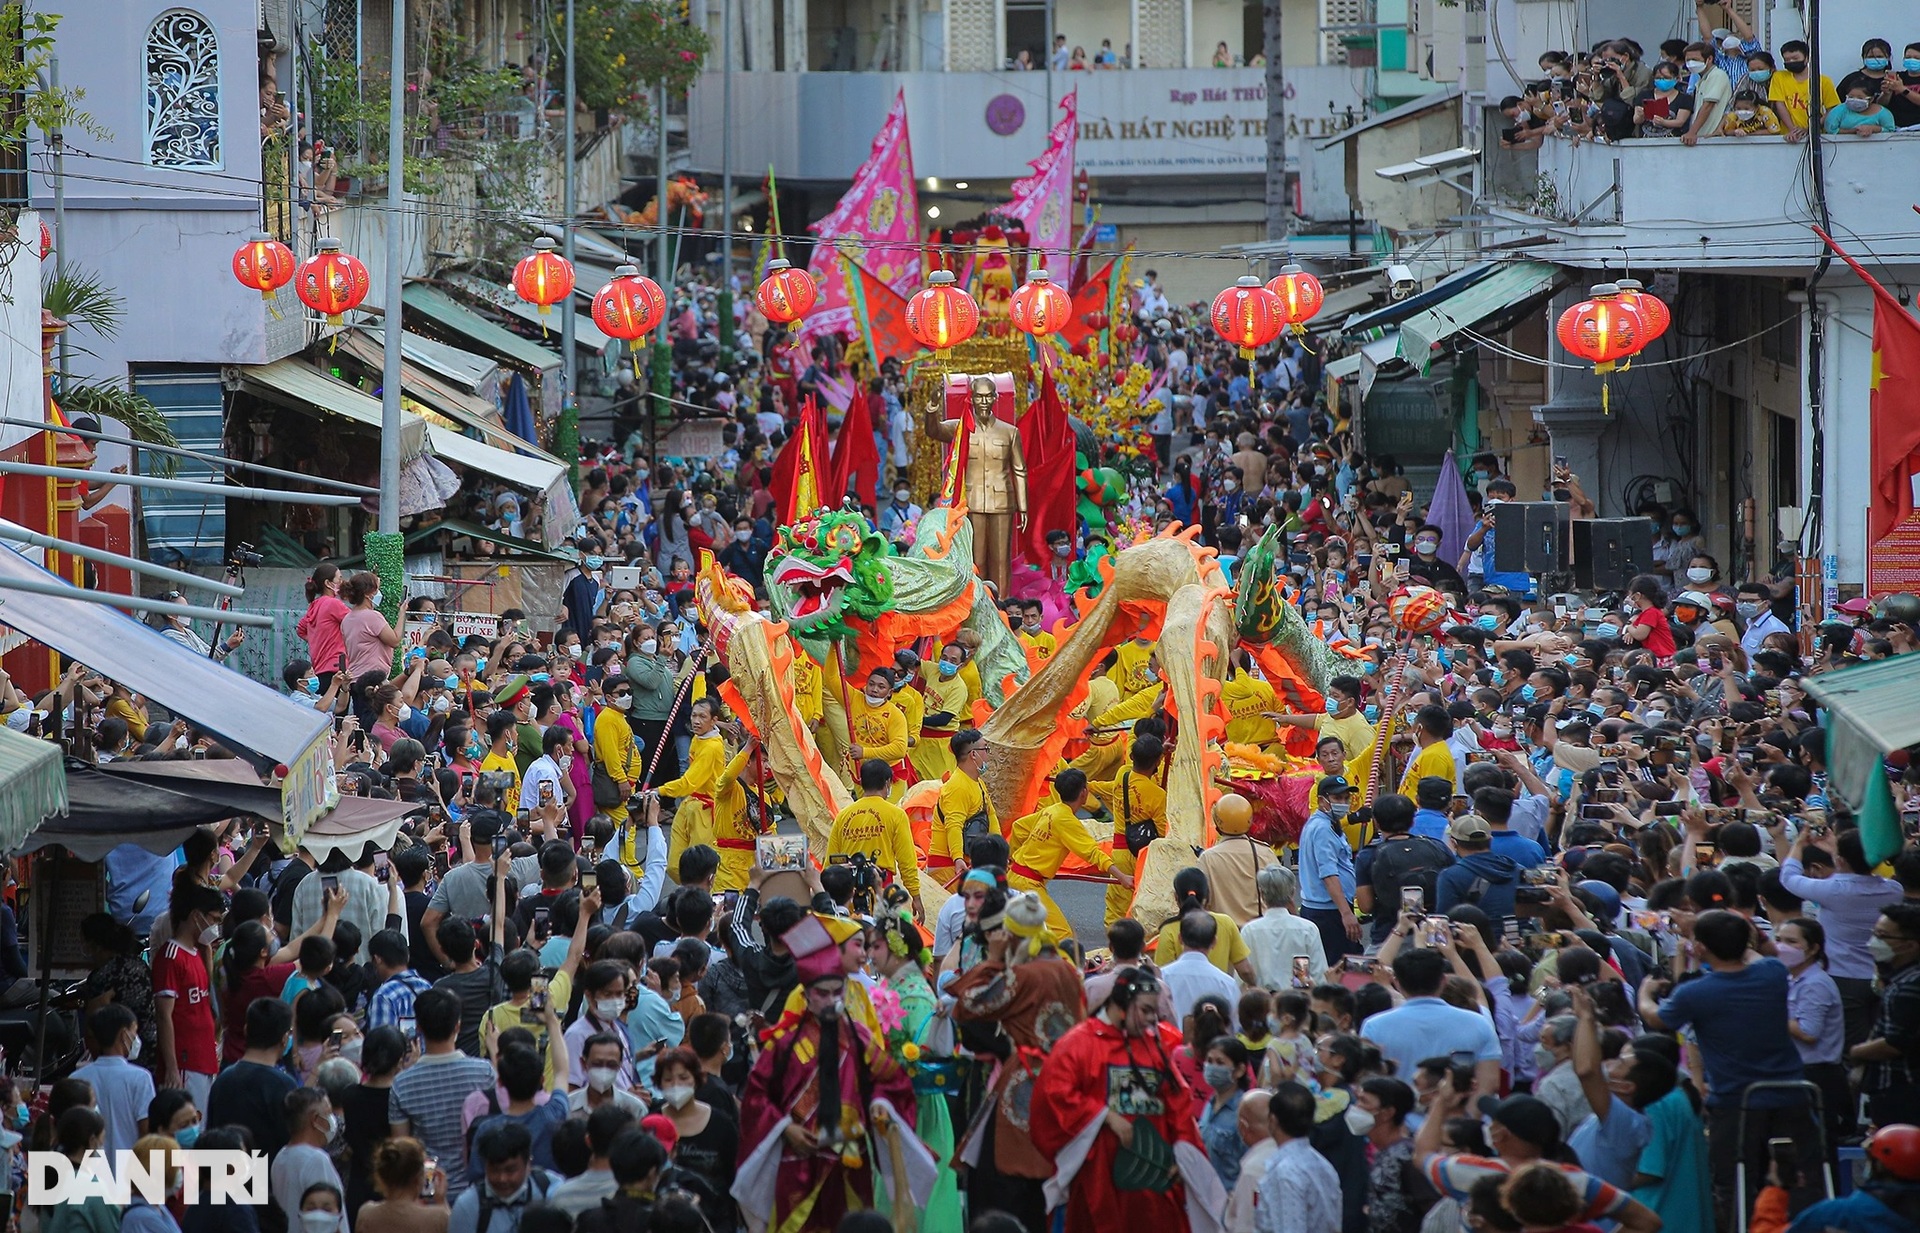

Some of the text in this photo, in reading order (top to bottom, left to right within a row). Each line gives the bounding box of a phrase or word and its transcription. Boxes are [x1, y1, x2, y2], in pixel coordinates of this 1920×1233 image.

[1169, 89, 1198, 105] Rạp
[1202, 87, 1228, 102] Hát
[1233, 83, 1266, 101] THỦ
[1120, 115, 1167, 140] HÁT
[1171, 114, 1235, 143] NGHỆ
[1239, 112, 1315, 142] THẬT
[479, 627, 494, 636] XE
